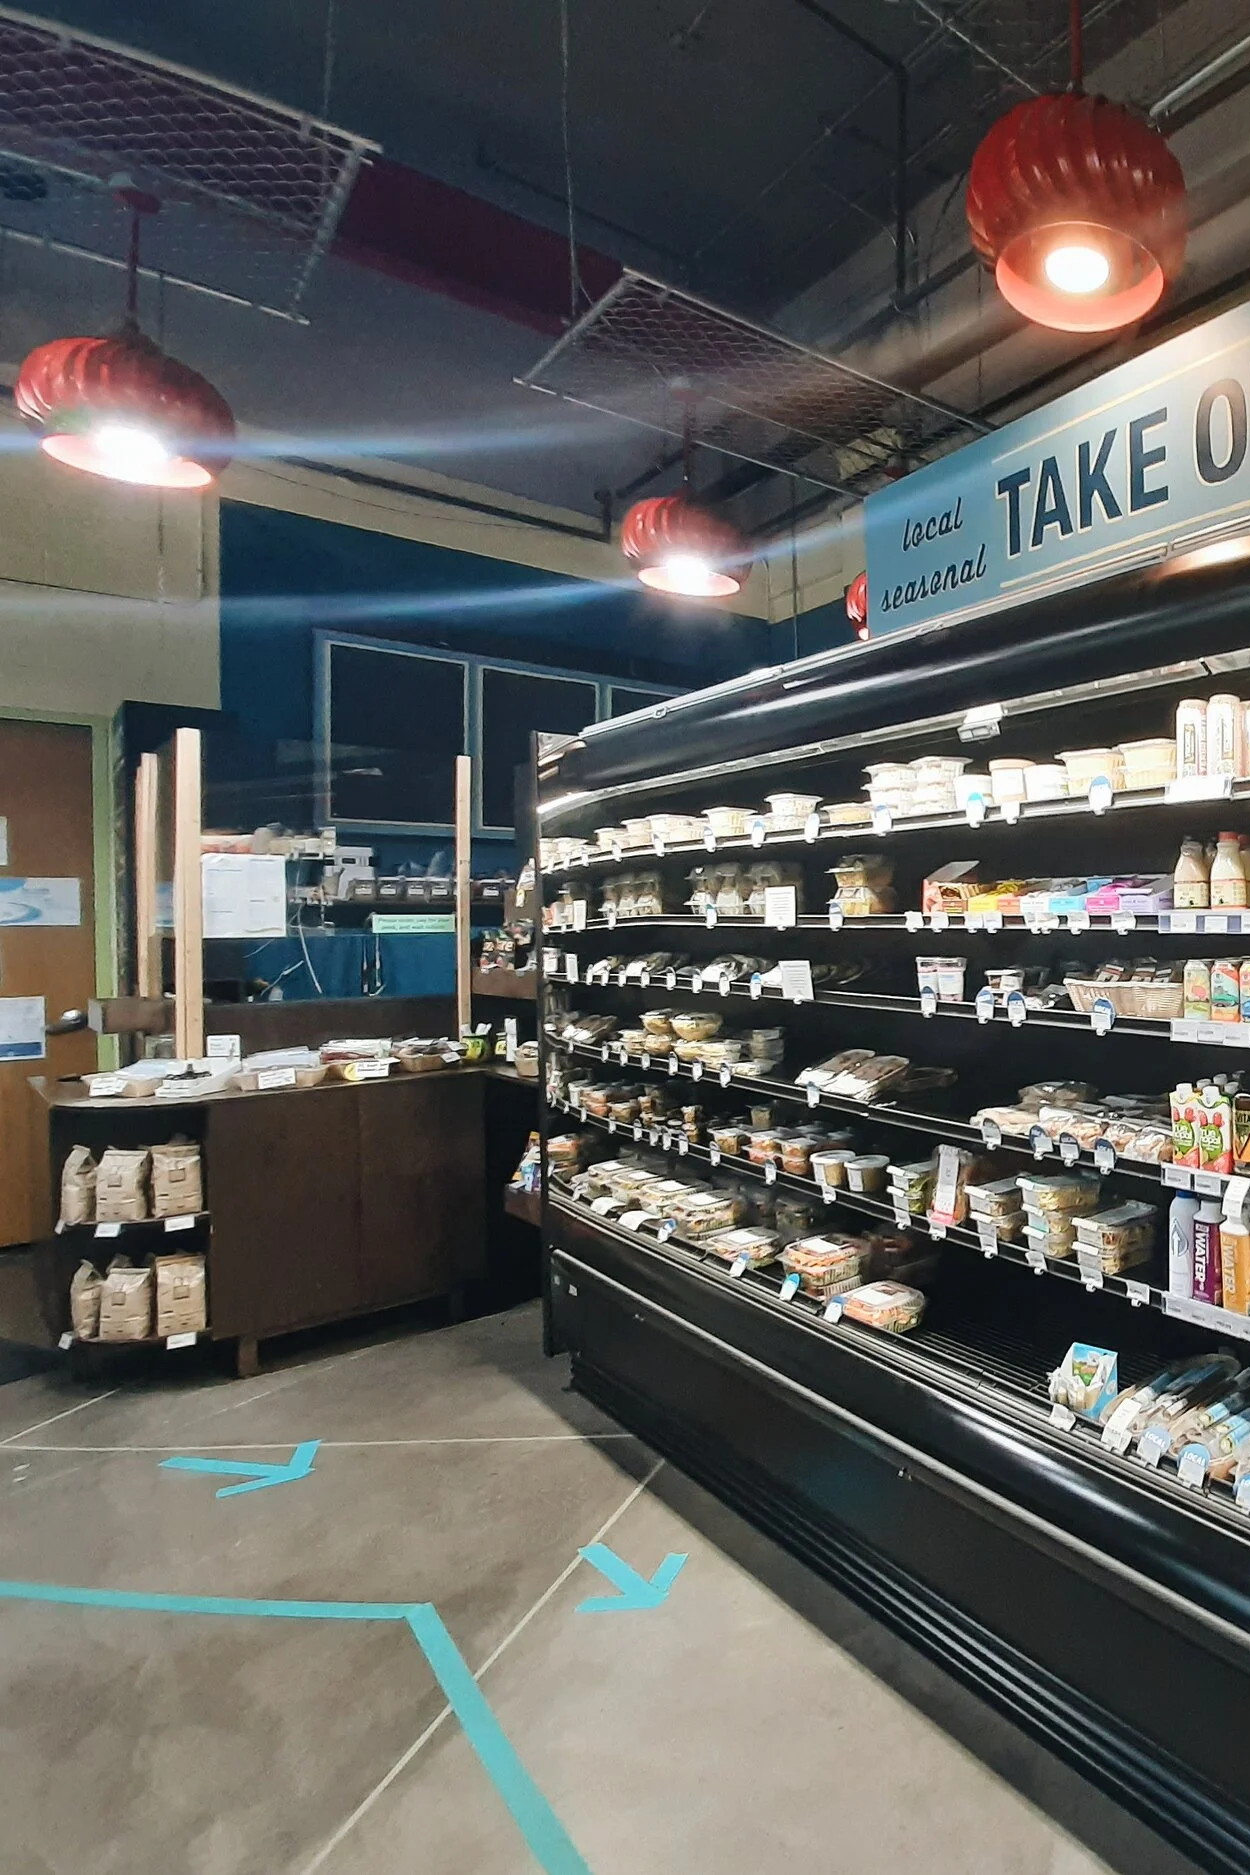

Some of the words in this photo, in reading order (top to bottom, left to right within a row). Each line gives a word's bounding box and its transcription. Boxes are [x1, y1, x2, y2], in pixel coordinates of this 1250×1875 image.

[996, 408, 1170, 557] TAKE
[901, 497, 963, 553] local
[880, 543, 987, 613] seasonal
[1195, 1235, 1207, 1282] WATER
[1145, 1431, 1167, 1449] LOCAL
[1184, 1450, 1206, 1467] LOCAL
